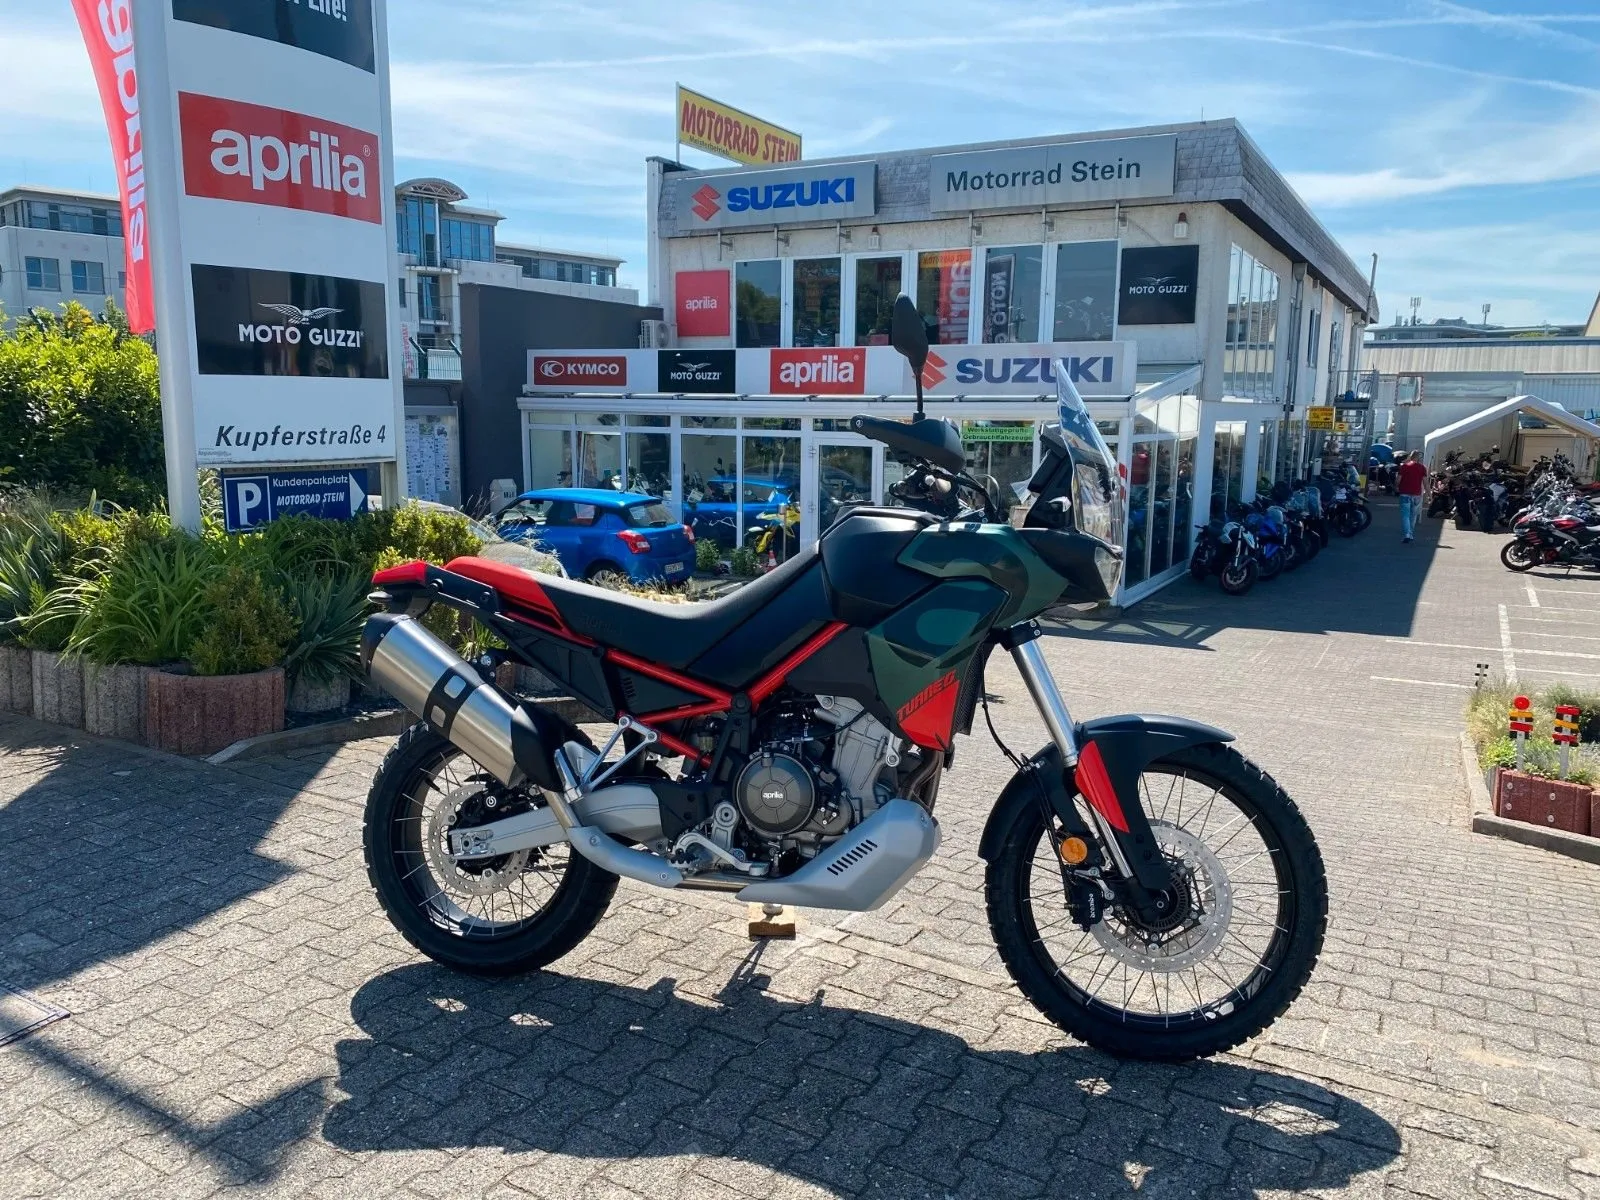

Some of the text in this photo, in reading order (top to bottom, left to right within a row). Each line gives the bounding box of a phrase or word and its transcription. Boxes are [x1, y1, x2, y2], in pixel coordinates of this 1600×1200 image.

[681, 100, 799, 163] MOTORRAD STEIN
[210, 128, 367, 199] aprilia
[946, 157, 1141, 192] Motorrad Stein
[727, 177, 855, 213] SUZUKI
[685, 296, 717, 311] aprilia
[1129, 285, 1187, 295] MOTO GUZZI
[238, 323, 361, 348] MOTO GUZZI
[567, 363, 620, 375] KYMCO
[670, 371, 720, 380] MOTO GUZZI
[779, 355, 855, 388] aprilia
[955, 356, 1114, 384] SUZUKI
[215, 424, 386, 451] Kupferstraße 4
[272, 475, 349, 488] Kundenparkplatz
[237, 482, 262, 526] P
[276, 491, 345, 507] MOTORRAD STEIN
